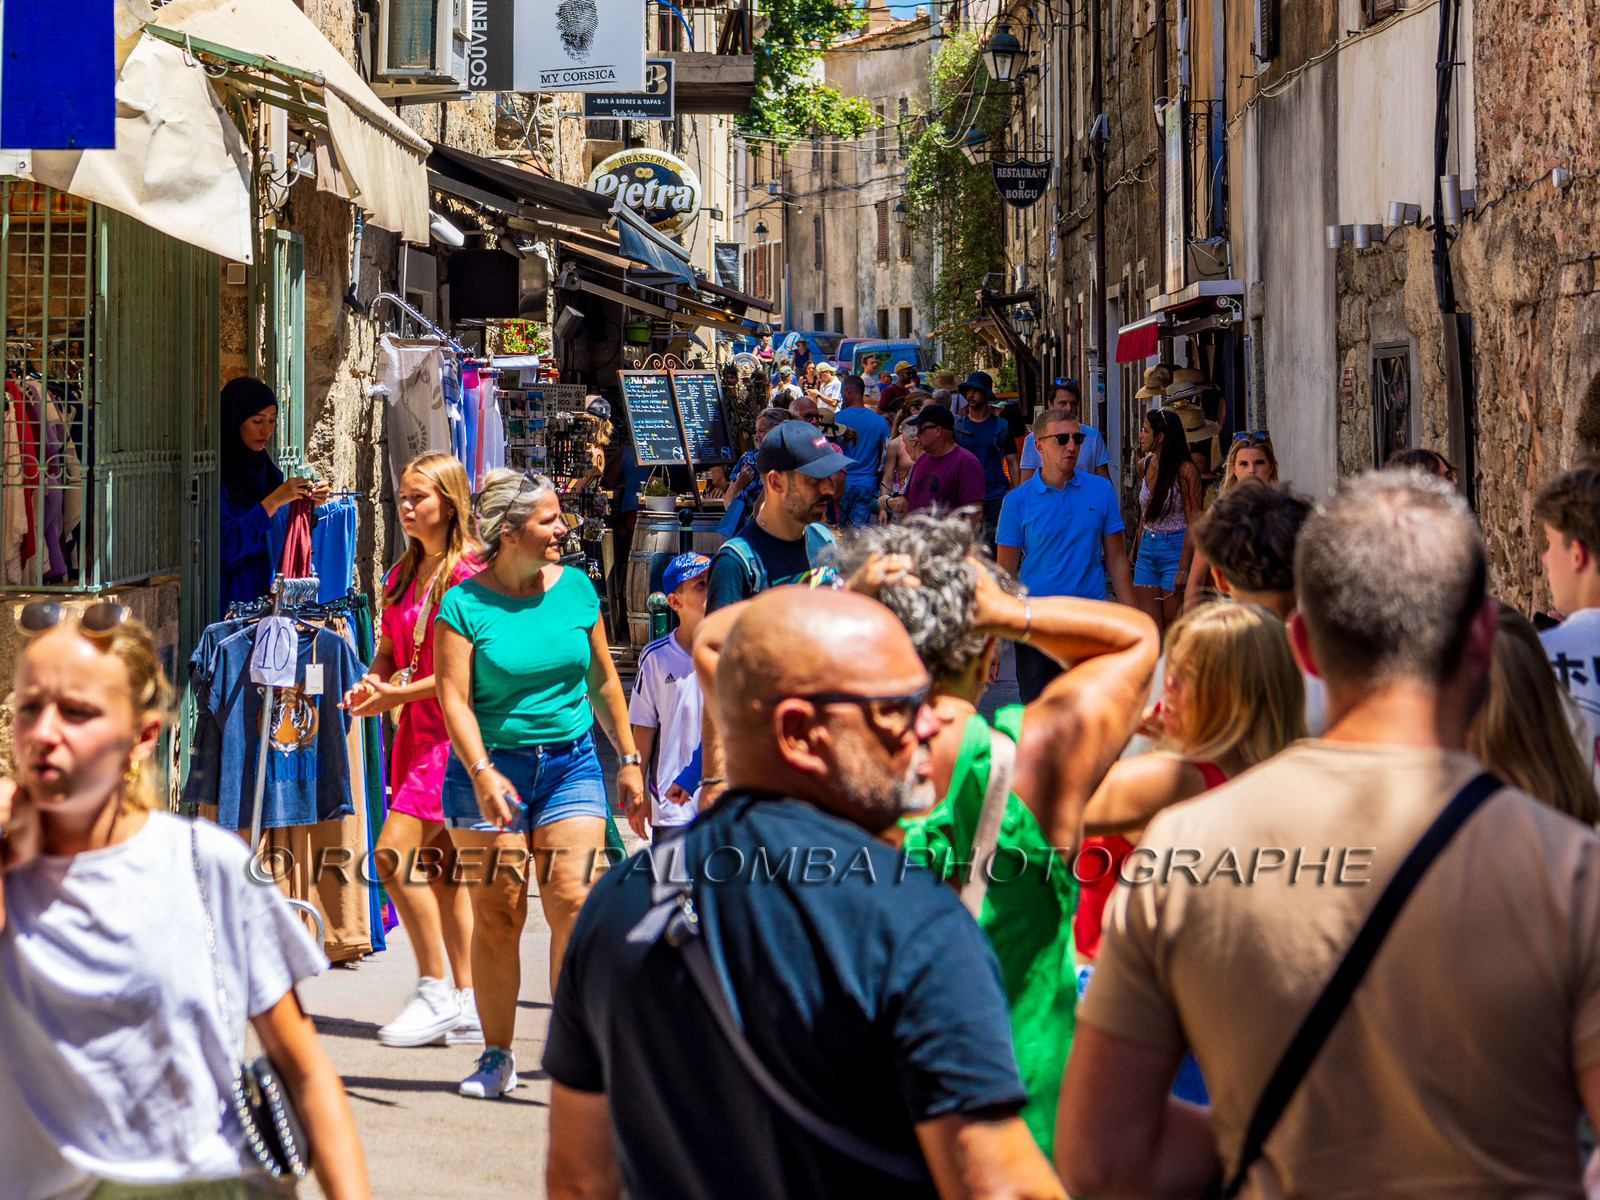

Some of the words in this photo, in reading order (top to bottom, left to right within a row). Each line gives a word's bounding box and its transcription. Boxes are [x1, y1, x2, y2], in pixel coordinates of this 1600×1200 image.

[540, 73, 560, 84] MY
[563, 69, 616, 82] CORSICA
[620, 154, 671, 168] BRASSERIE
[997, 168, 1047, 178] RESTAURANT
[1018, 180, 1025, 189] U
[596, 173, 694, 211] Pietra
[1005, 190, 1038, 199] BORGU
[255, 625, 292, 671] 10
